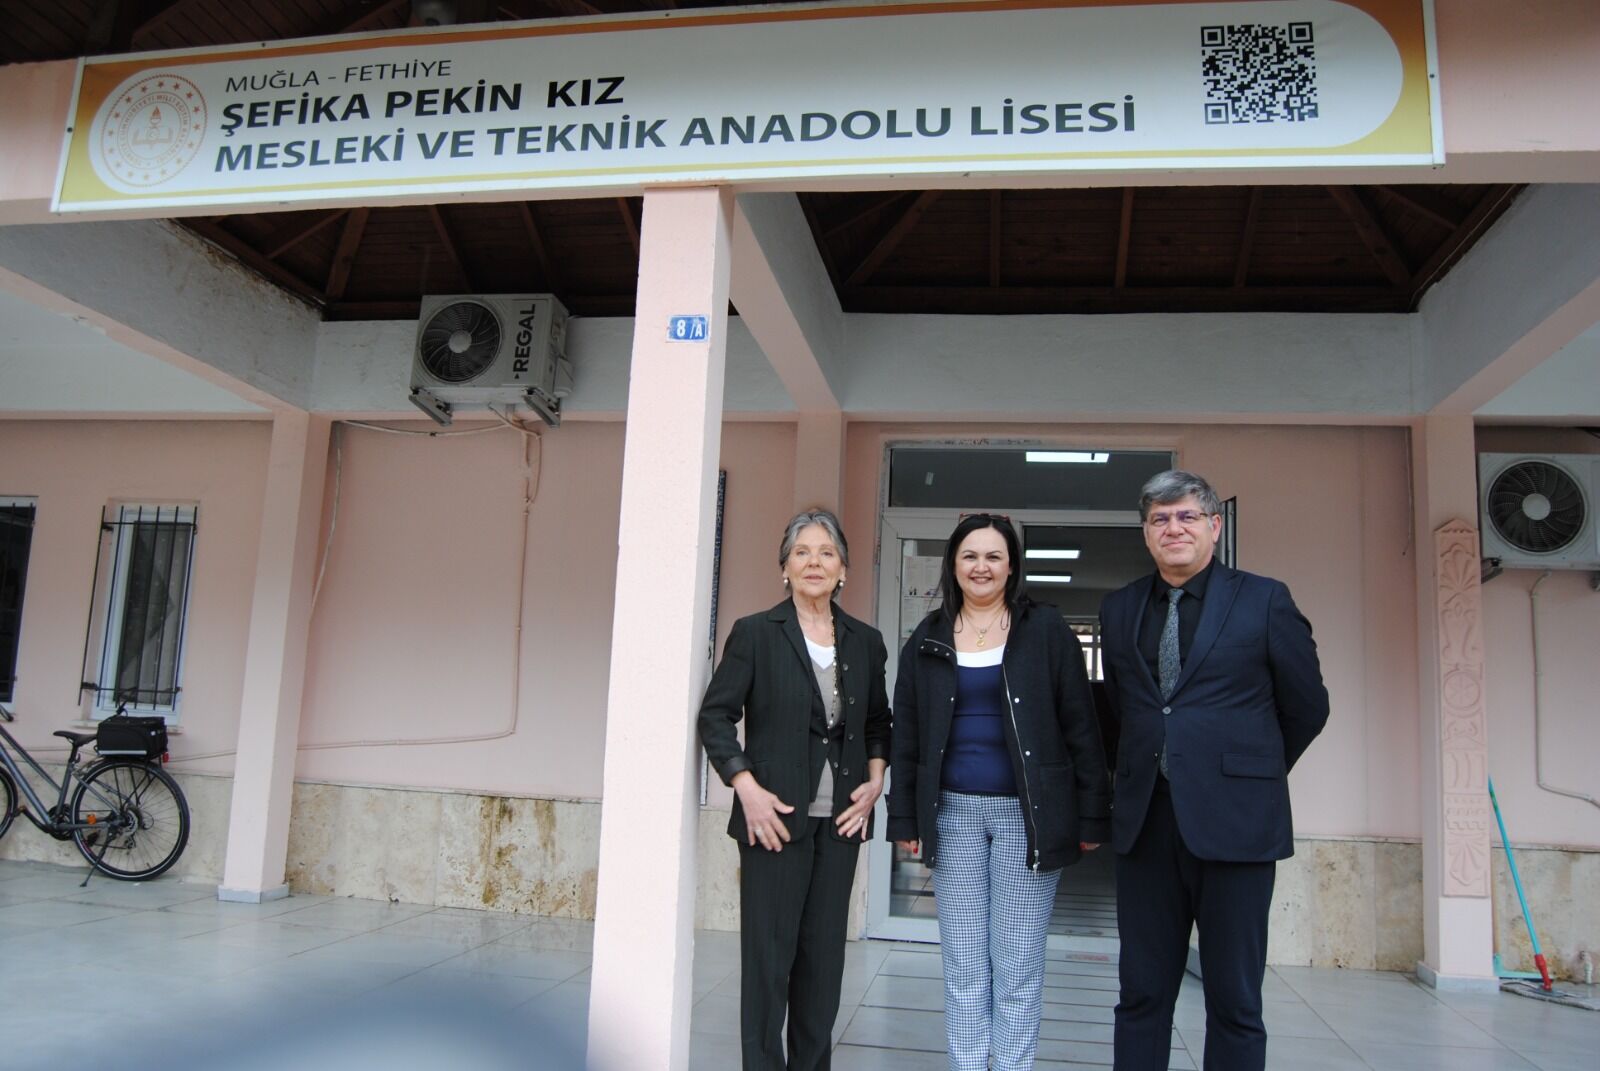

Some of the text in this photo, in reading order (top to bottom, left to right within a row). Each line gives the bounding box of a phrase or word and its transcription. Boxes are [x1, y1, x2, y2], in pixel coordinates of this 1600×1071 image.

[221, 93, 370, 137] ŞEFİKA
[385, 79, 522, 118] PEKİN
[547, 77, 624, 108] KIZ
[226, 70, 319, 92] MUĞLA
[345, 59, 451, 83] FETHİYE
[215, 128, 404, 172] MESLEKİ
[417, 130, 475, 159] VE
[487, 115, 667, 155] TEKNİK
[680, 108, 951, 146] ANADOLU
[971, 95, 1135, 136] LİSESİ
[513, 304, 536, 372] REGAL
